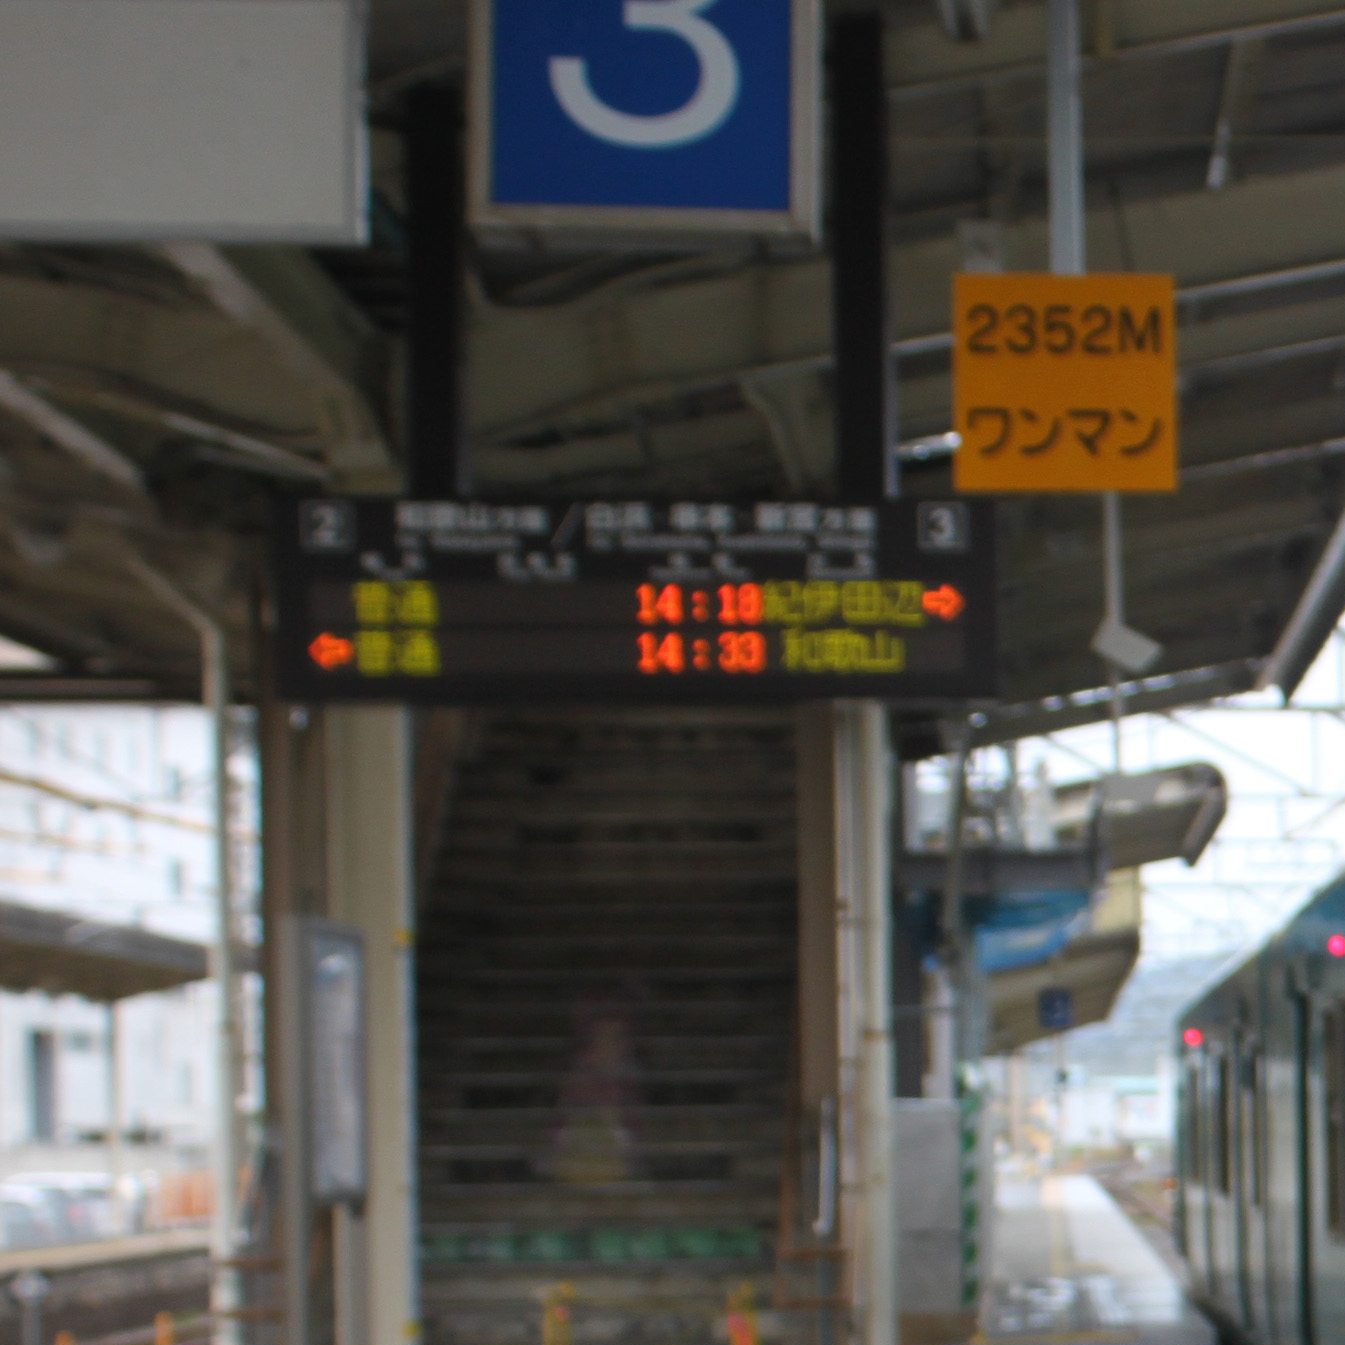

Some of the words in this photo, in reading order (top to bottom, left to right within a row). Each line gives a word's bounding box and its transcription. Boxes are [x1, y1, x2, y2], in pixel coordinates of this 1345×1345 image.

[548, 0, 741, 149] 3
[965, 302, 1162, 355] 2352M
[965, 406, 1164, 456] ワンマン
[310, 505, 341, 548] 2
[927, 507, 956, 547] 3
[637, 582, 764, 625] 14:18
[637, 631, 767, 674] 14:33
